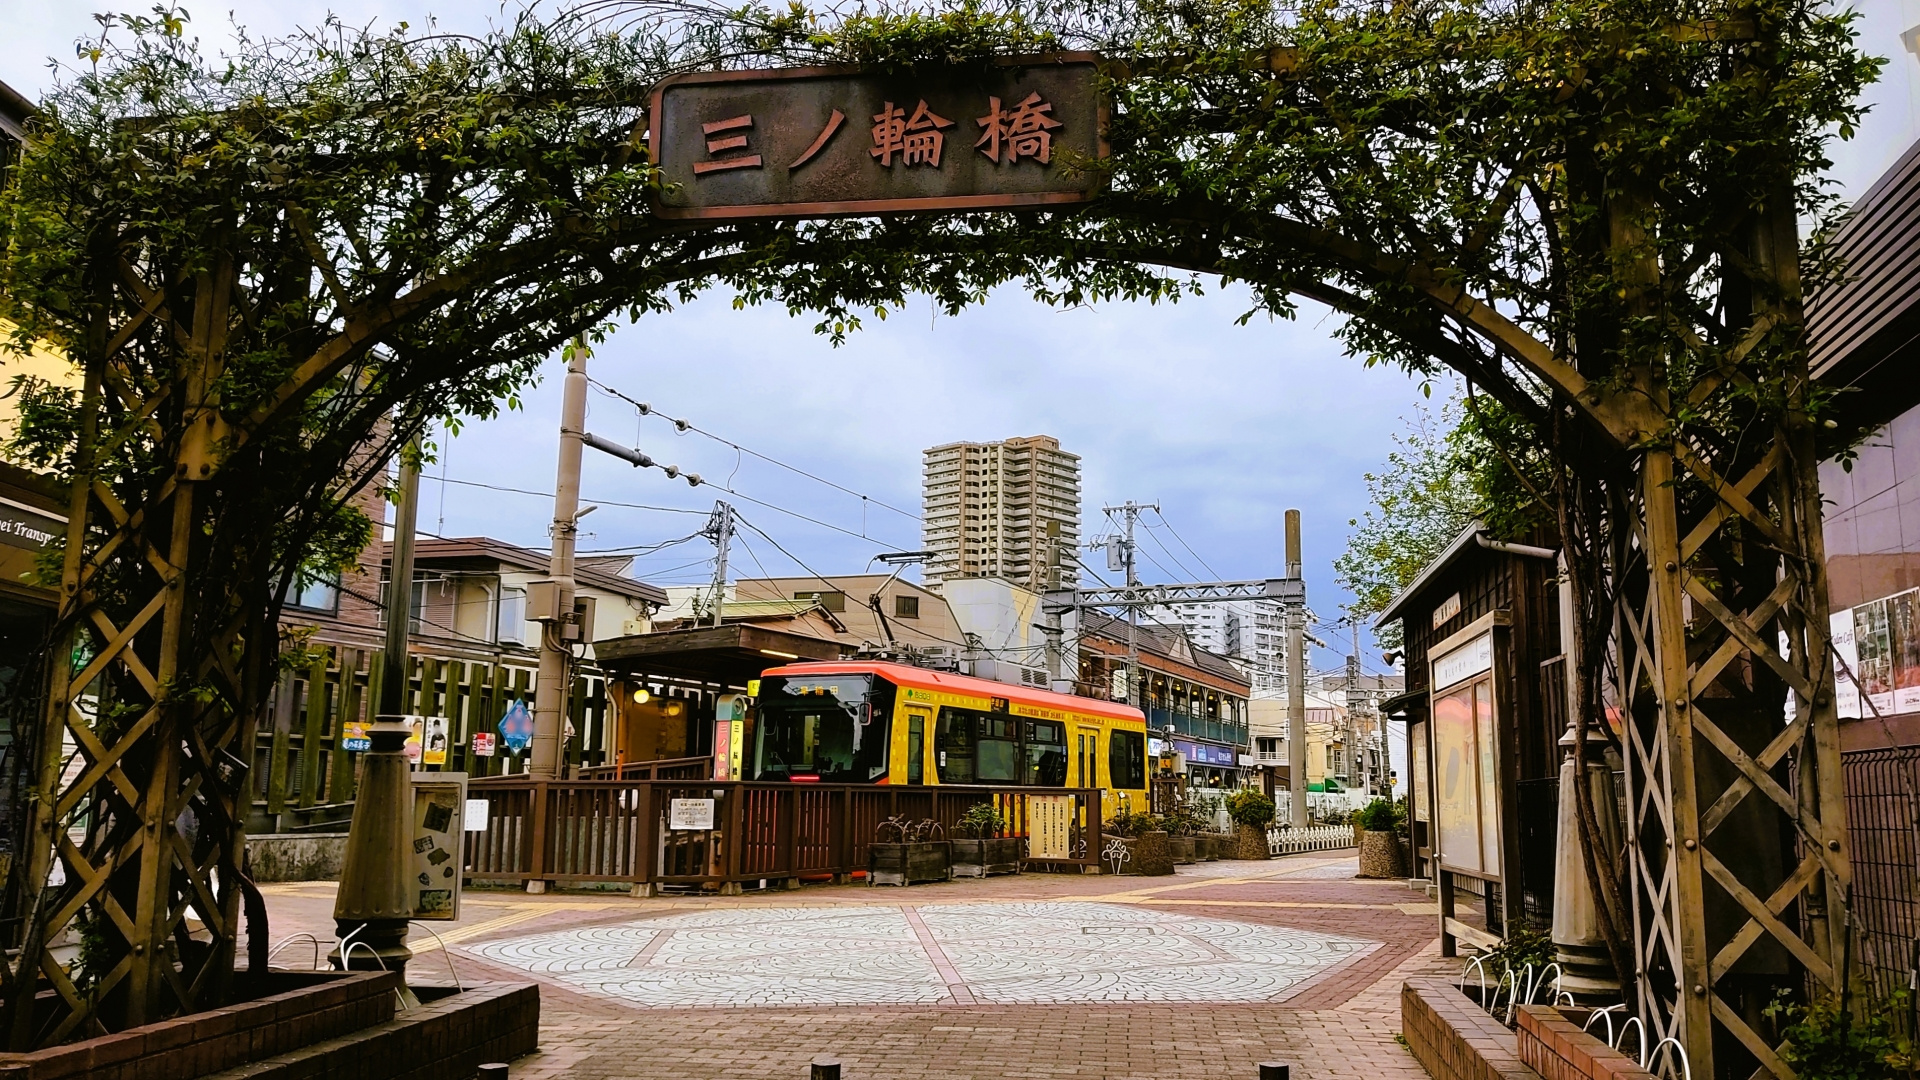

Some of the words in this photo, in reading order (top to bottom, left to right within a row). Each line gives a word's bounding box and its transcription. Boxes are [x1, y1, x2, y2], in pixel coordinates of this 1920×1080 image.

[693, 91, 1064, 174] 三ノ輪橋
[0, 519, 12, 533] ei
